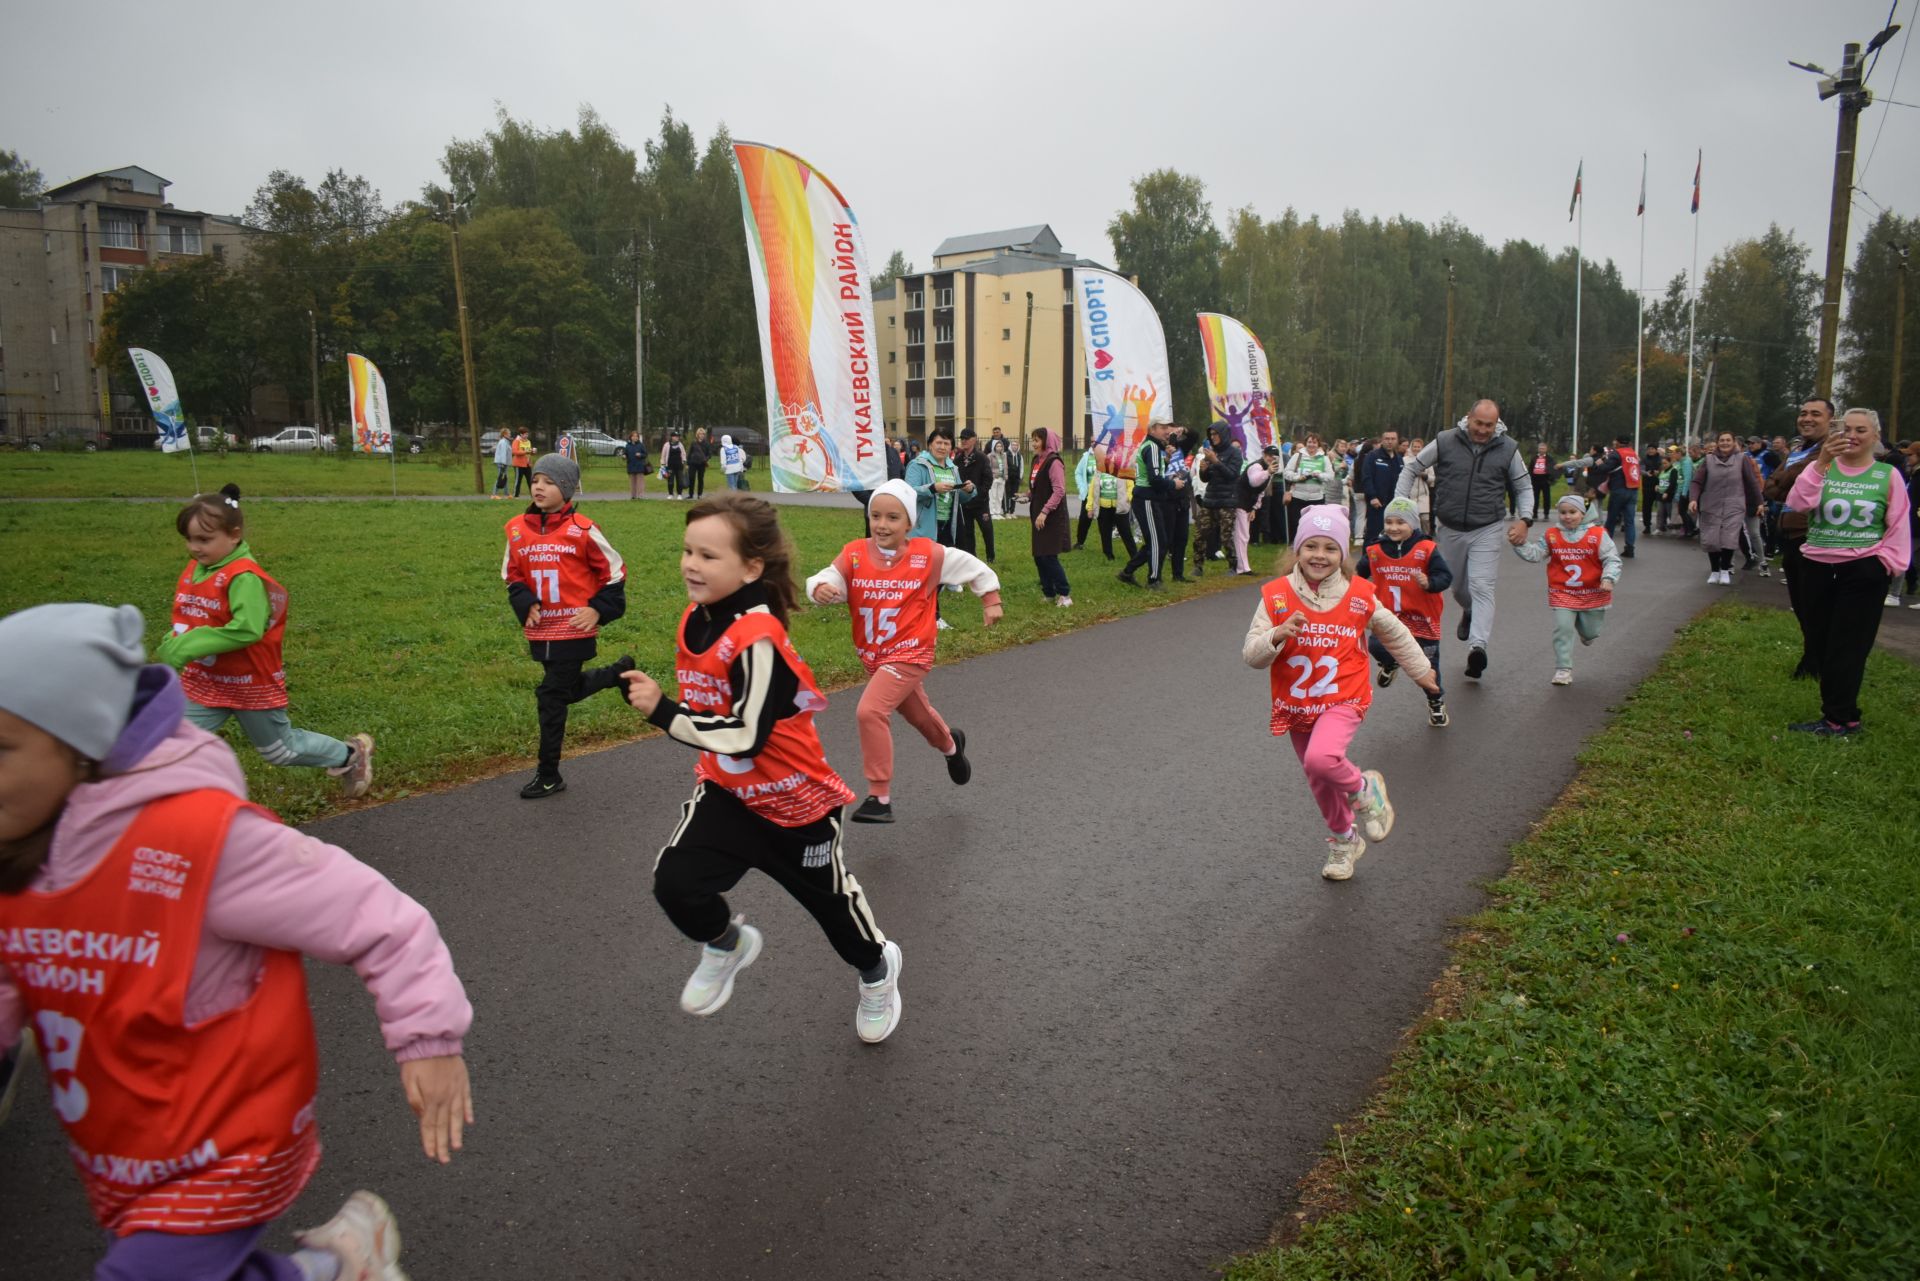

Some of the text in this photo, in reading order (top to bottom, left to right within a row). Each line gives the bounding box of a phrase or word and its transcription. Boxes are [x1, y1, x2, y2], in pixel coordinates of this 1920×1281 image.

[1084, 278, 1115, 382] Я СПОРТ!
[831, 222, 874, 462] ТУКАЕВСКИЙ РАЙОН
[1822, 479, 1880, 491] УКАЕВСКИЙ
[1828, 486, 1864, 496] РАЙОН
[528, 553, 560, 562] РАЙОН
[851, 578, 921, 590] ТУКАЕВСКИЙ
[1564, 564, 1584, 587] 2
[530, 569, 560, 604] 11
[863, 590, 903, 600] РАЙОН
[1389, 586, 1401, 612] 1
[858, 607, 901, 646] 15
[1300, 622, 1357, 639] АЕВСКИЙ
[1296, 634, 1339, 648] РАЙОН
[1286, 654, 1340, 700] 22
